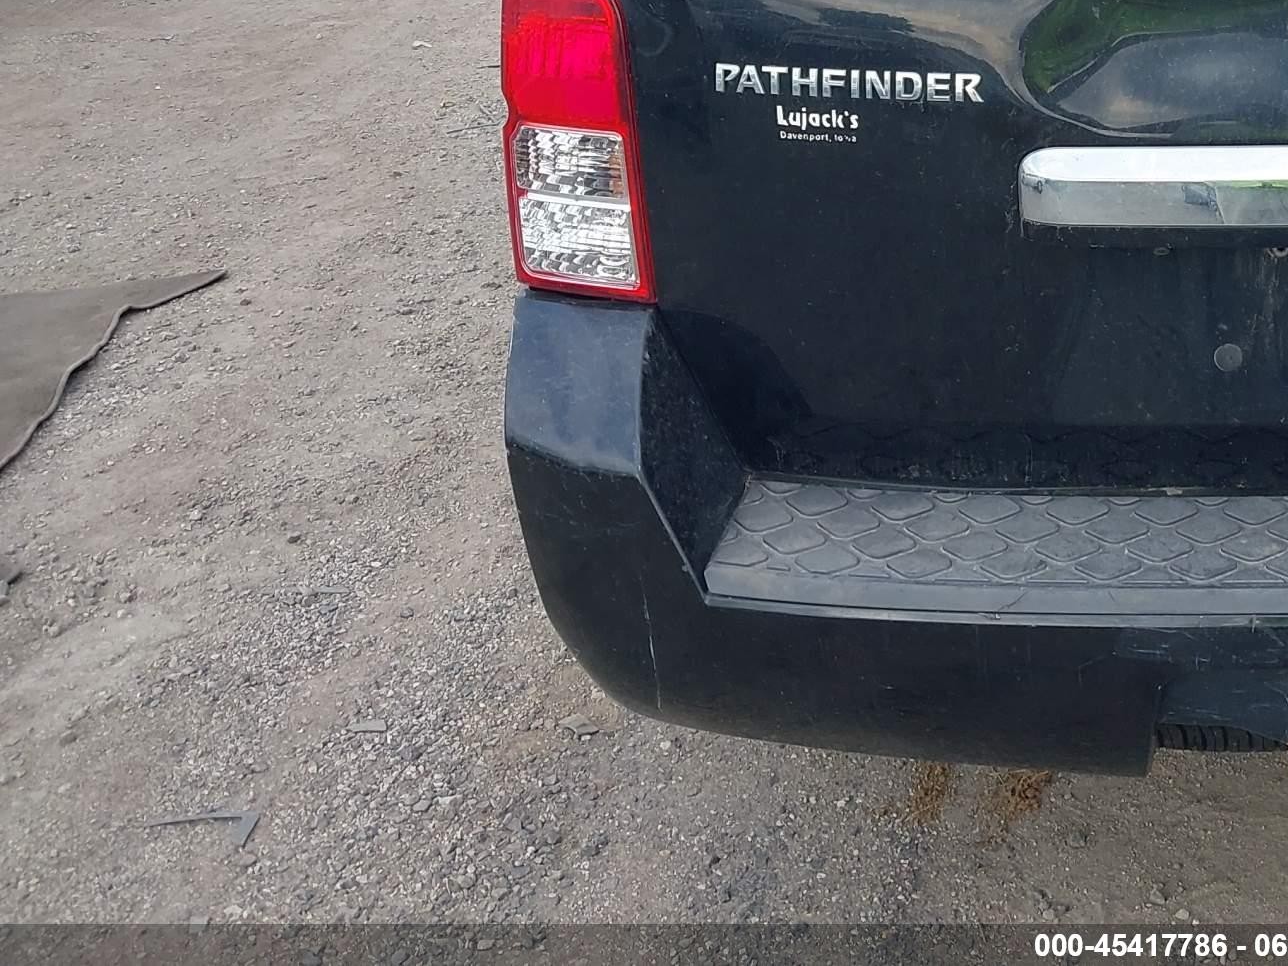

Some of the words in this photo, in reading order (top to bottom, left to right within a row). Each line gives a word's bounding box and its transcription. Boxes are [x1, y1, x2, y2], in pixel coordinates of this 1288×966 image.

[714, 61, 985, 104] PATHFINDER
[775, 104, 860, 132] Lujack's
[779, 130, 833, 143] Davenport,
